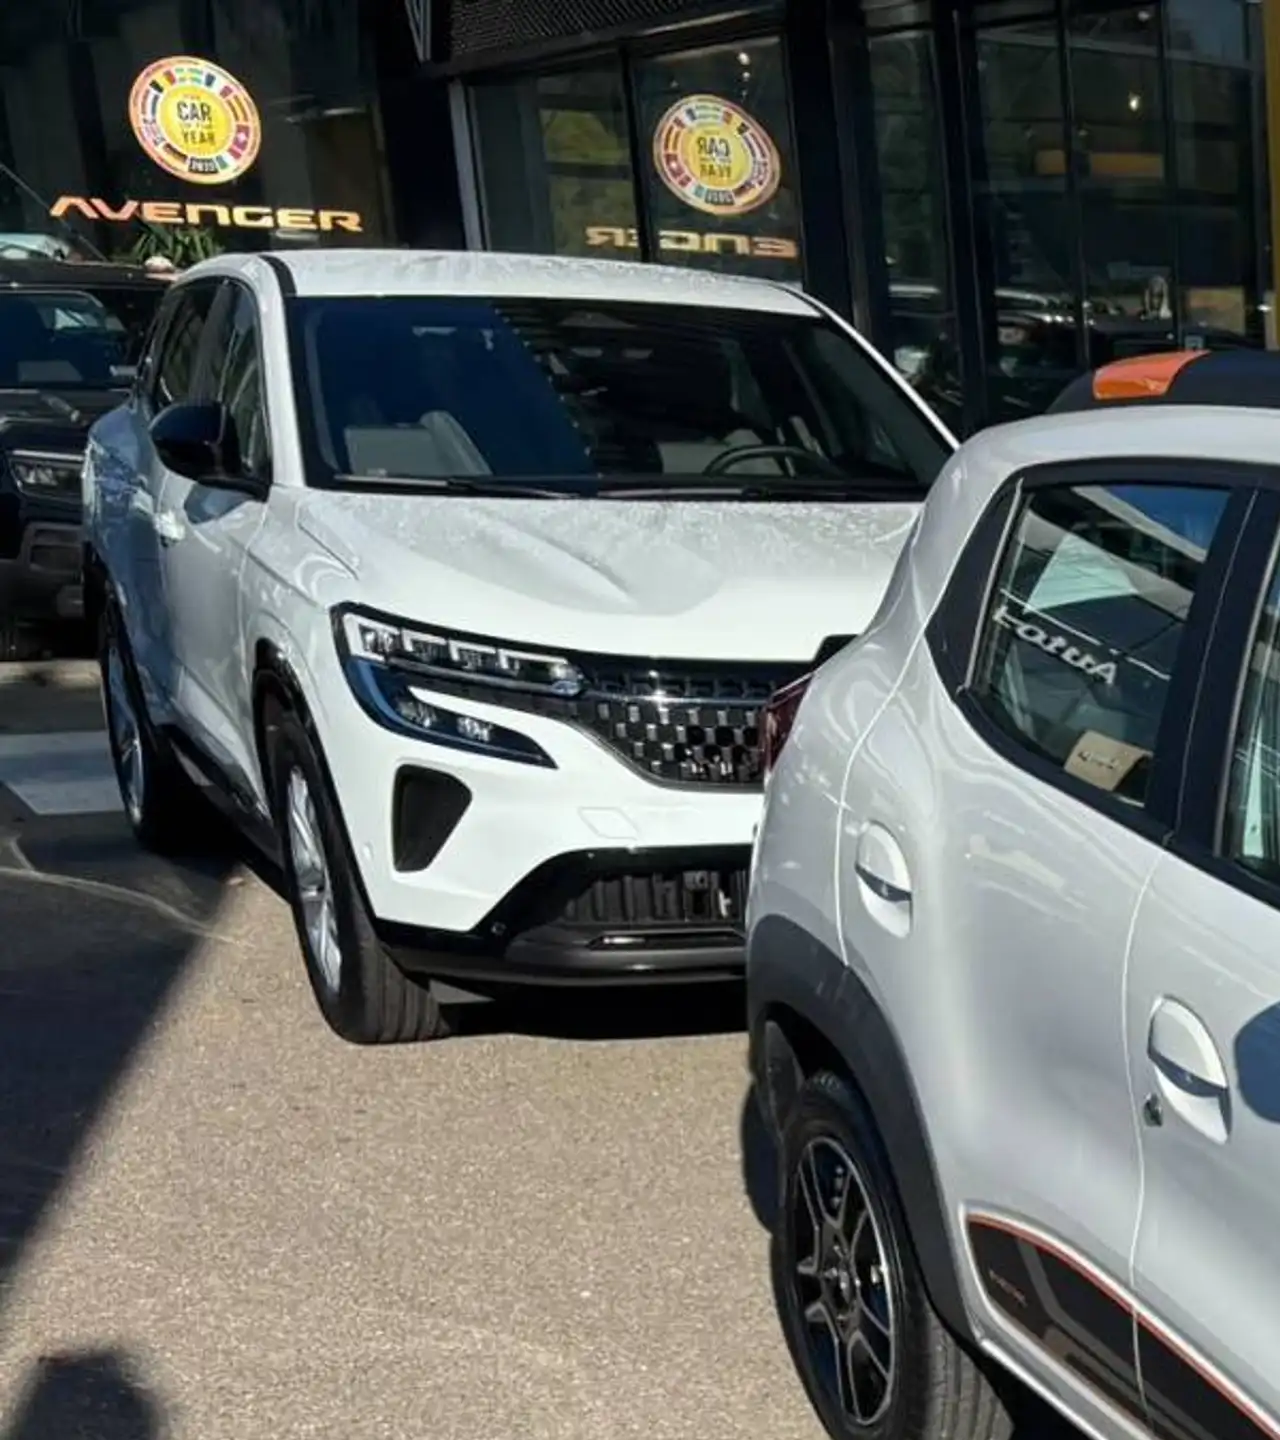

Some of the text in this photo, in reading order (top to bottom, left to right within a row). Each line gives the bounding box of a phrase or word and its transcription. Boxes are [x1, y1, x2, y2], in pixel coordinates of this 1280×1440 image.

[176, 101, 211, 121] CAR
[182, 128, 216, 147] YEAR
[50, 195, 364, 232] AVENGER
